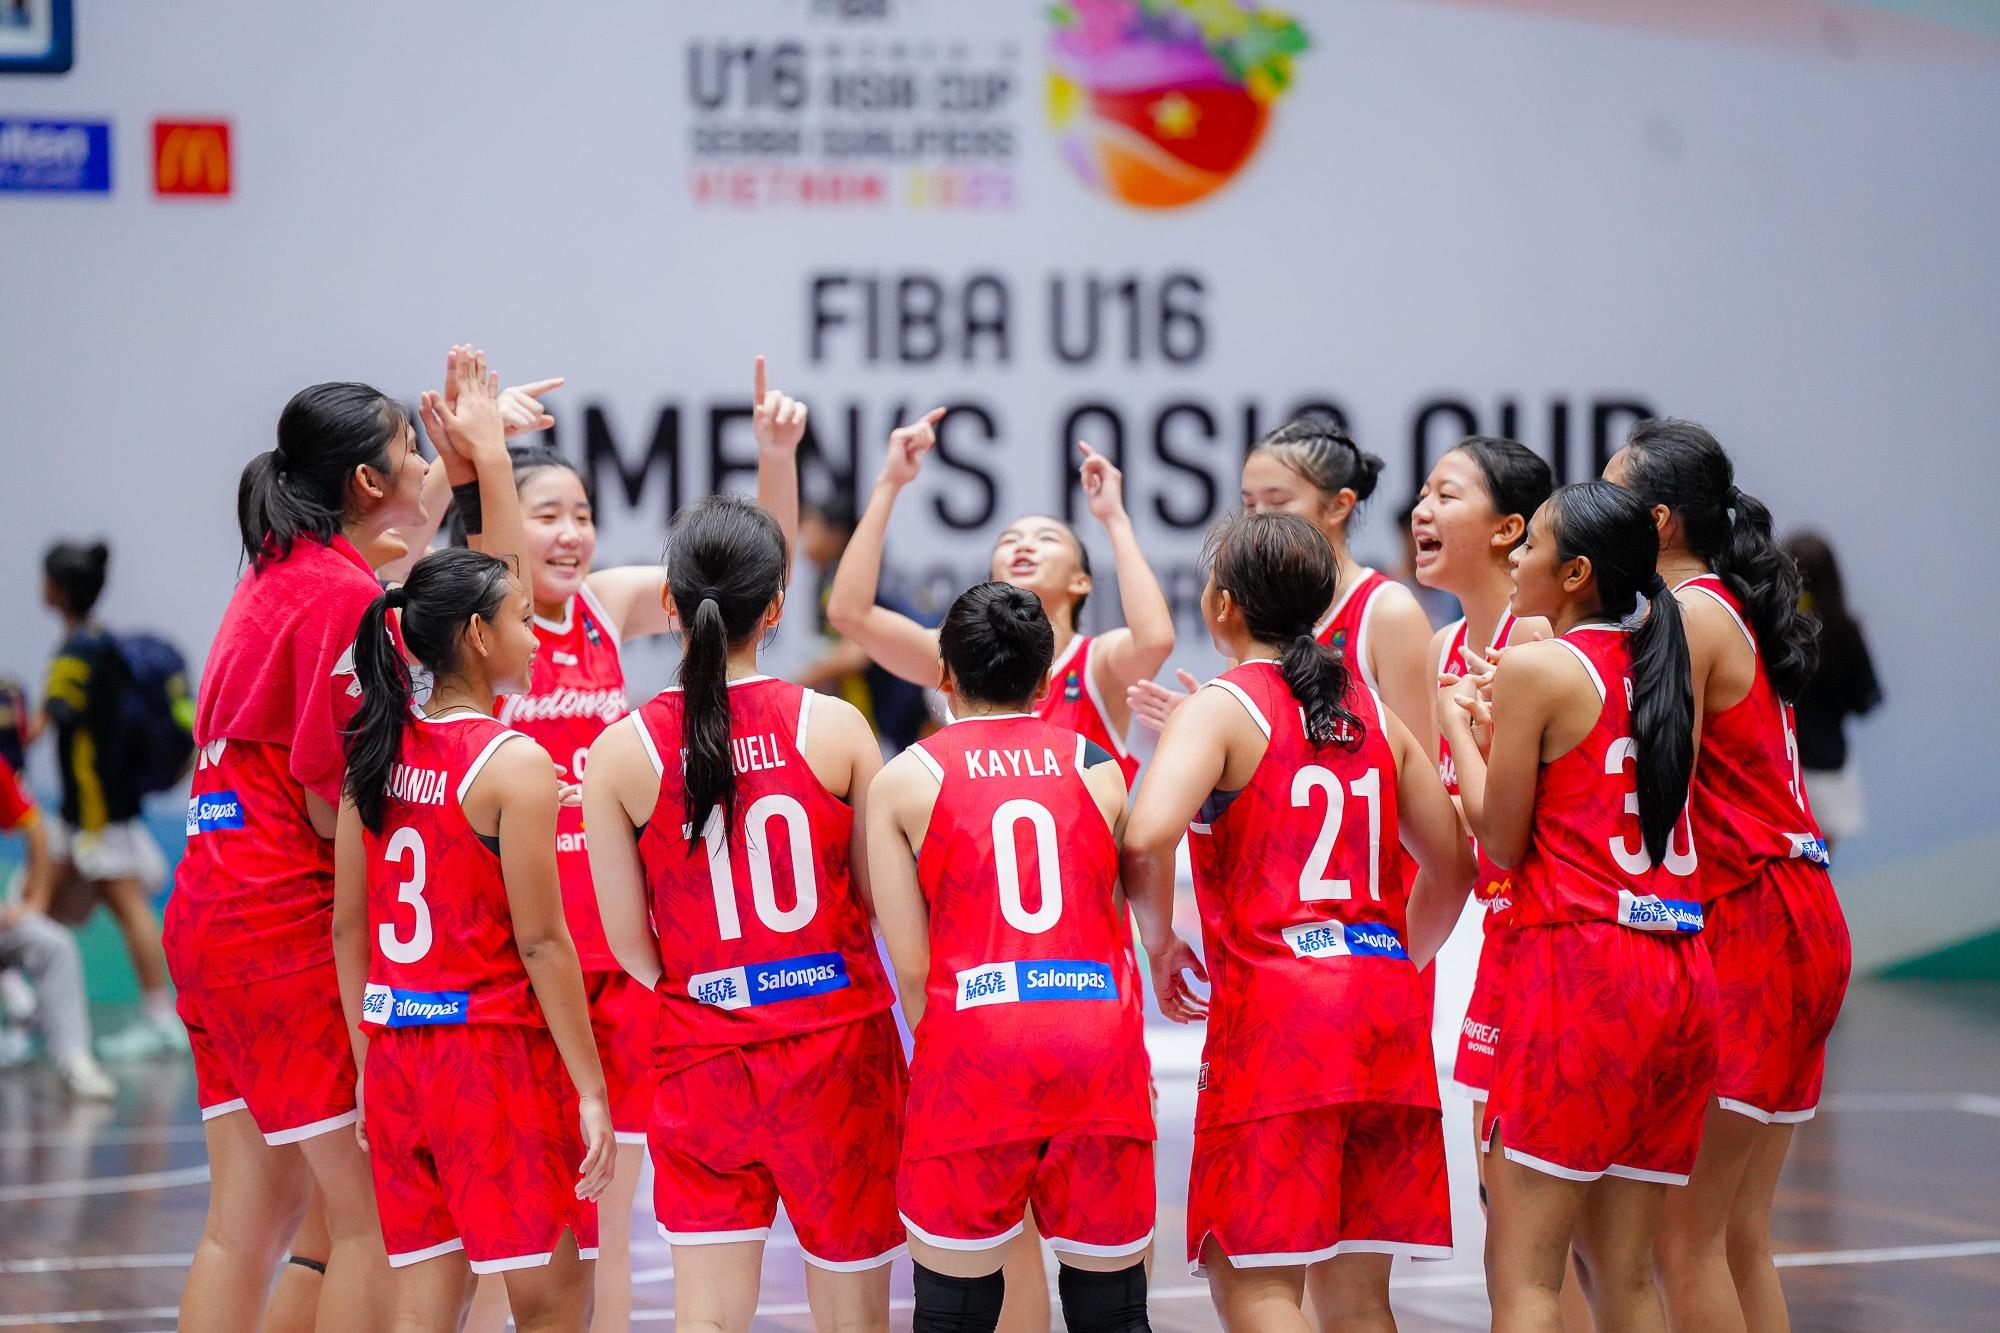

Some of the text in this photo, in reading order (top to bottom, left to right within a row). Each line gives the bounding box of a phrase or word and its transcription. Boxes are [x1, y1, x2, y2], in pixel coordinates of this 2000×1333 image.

[686, 41, 806, 110] U16
[810, 273, 1207, 364] FIBA U16
[965, 747, 1063, 780] KAYLA
[1290, 764, 1382, 903] 21
[682, 794, 819, 942] 10
[991, 798, 1064, 935] 0
[378, 826, 433, 964] 3
[1629, 910, 1668, 923] MOVE
[1297, 927, 1332, 946] LET'S
[1299, 936, 1337, 953] MOVE
[698, 963, 836, 996] LET'S Salonpas
[700, 985, 737, 1004] MOVE
[965, 980, 1006, 1001] MOVE
[966, 968, 1106, 991] LET'S Salonpas
[394, 998, 459, 1019] alonpas
